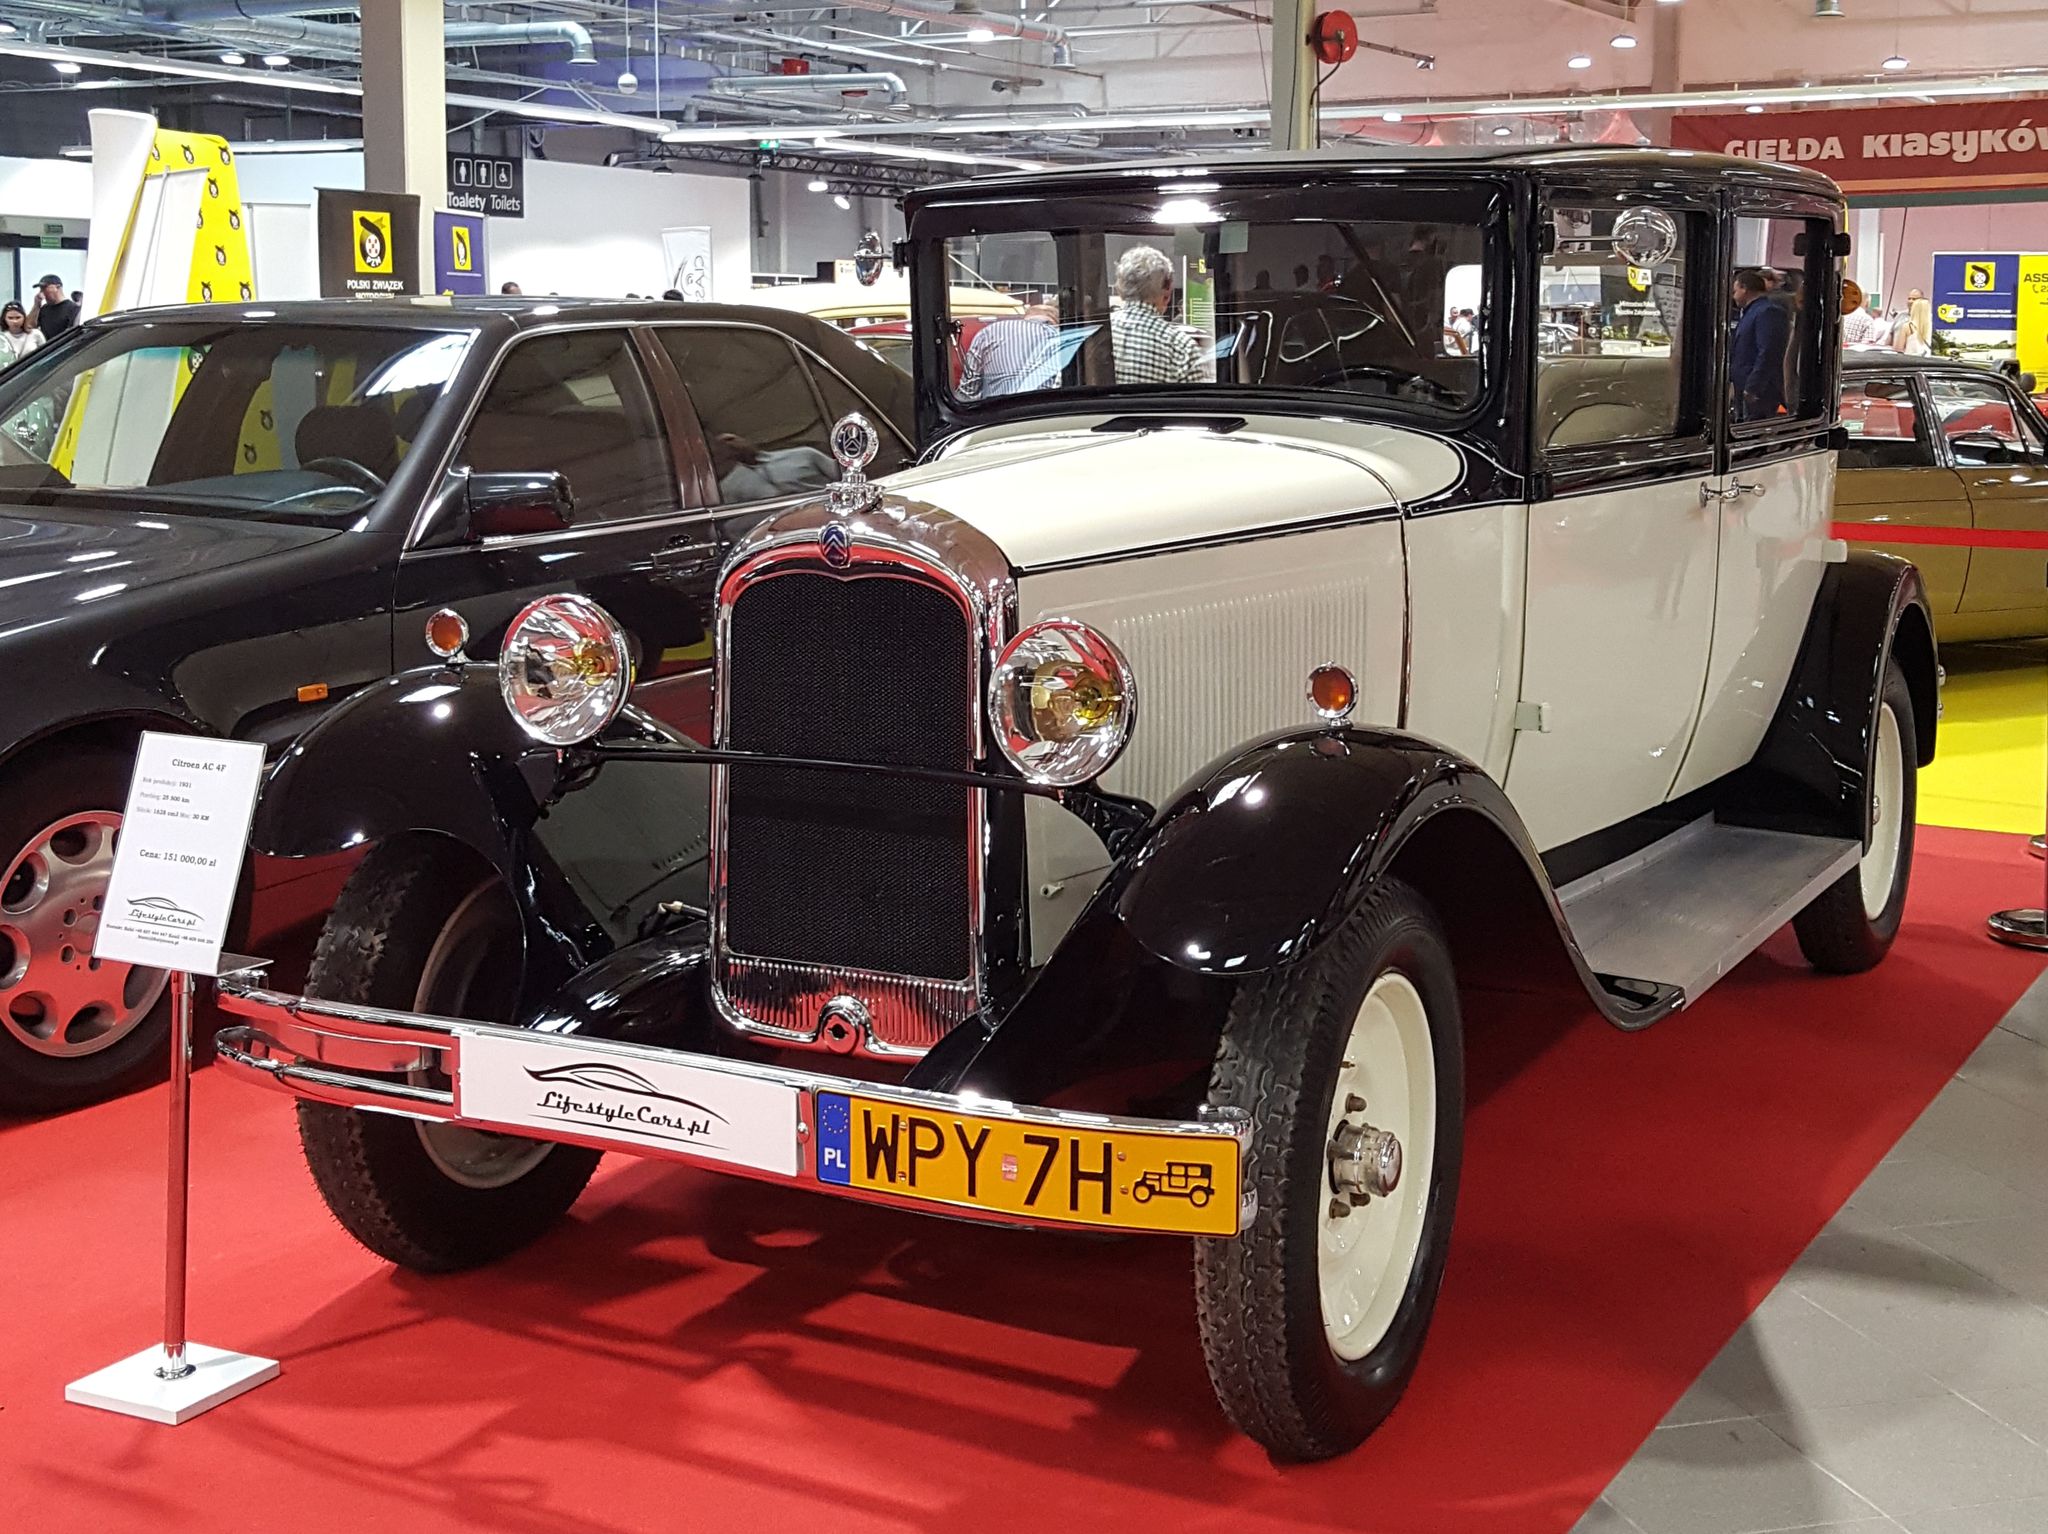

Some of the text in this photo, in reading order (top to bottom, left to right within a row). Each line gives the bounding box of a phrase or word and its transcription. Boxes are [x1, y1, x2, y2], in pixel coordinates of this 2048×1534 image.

[1724, 136, 1845, 162] GIEŁDA
[447, 191, 521, 212] Toalety Toilets
[346, 279, 404, 292] POLSKI ZWIĄZEK
[172, 758, 227, 772] Citroen AC 4F
[139, 848, 162, 859] Cena:
[163, 852, 178, 862] 151
[180, 854, 207, 866] 000,00
[128, 908, 196, 926] LifestyleCars.pl
[536, 1090, 711, 1136] LifestyleCars.pl
[823, 1147, 847, 1169] PL
[863, 1109, 1113, 1215] WPY 7H
